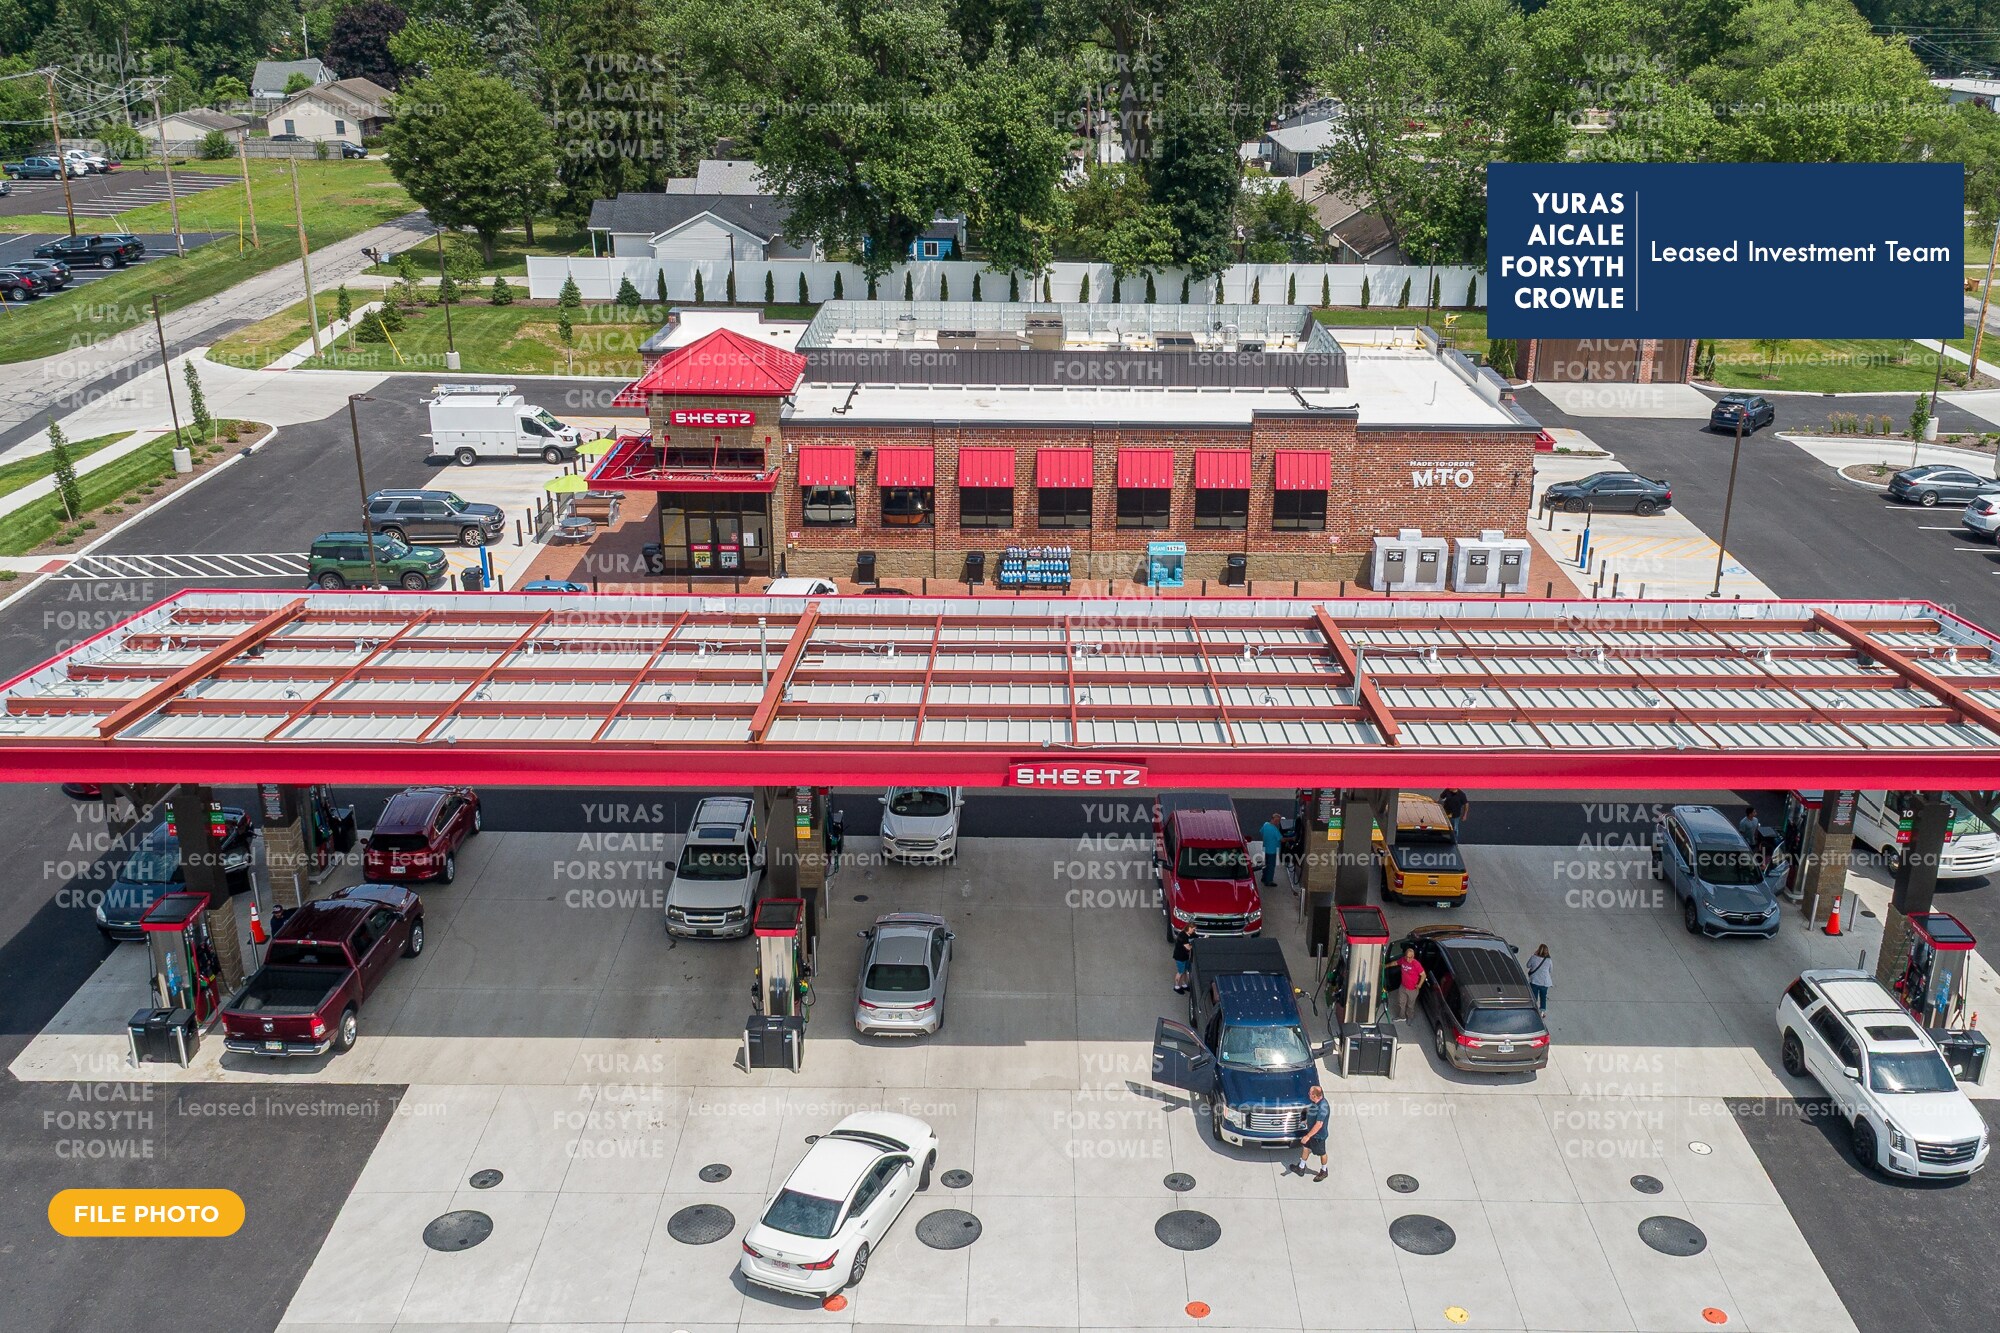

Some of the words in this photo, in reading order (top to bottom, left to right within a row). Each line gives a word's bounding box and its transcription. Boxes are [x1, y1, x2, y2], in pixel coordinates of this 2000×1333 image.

[675, 412, 751, 424] SHEETZ
[1017, 768, 1140, 785] SHEETZ
[210, 802, 221, 810] 15
[1903, 810, 1914, 818] 10
